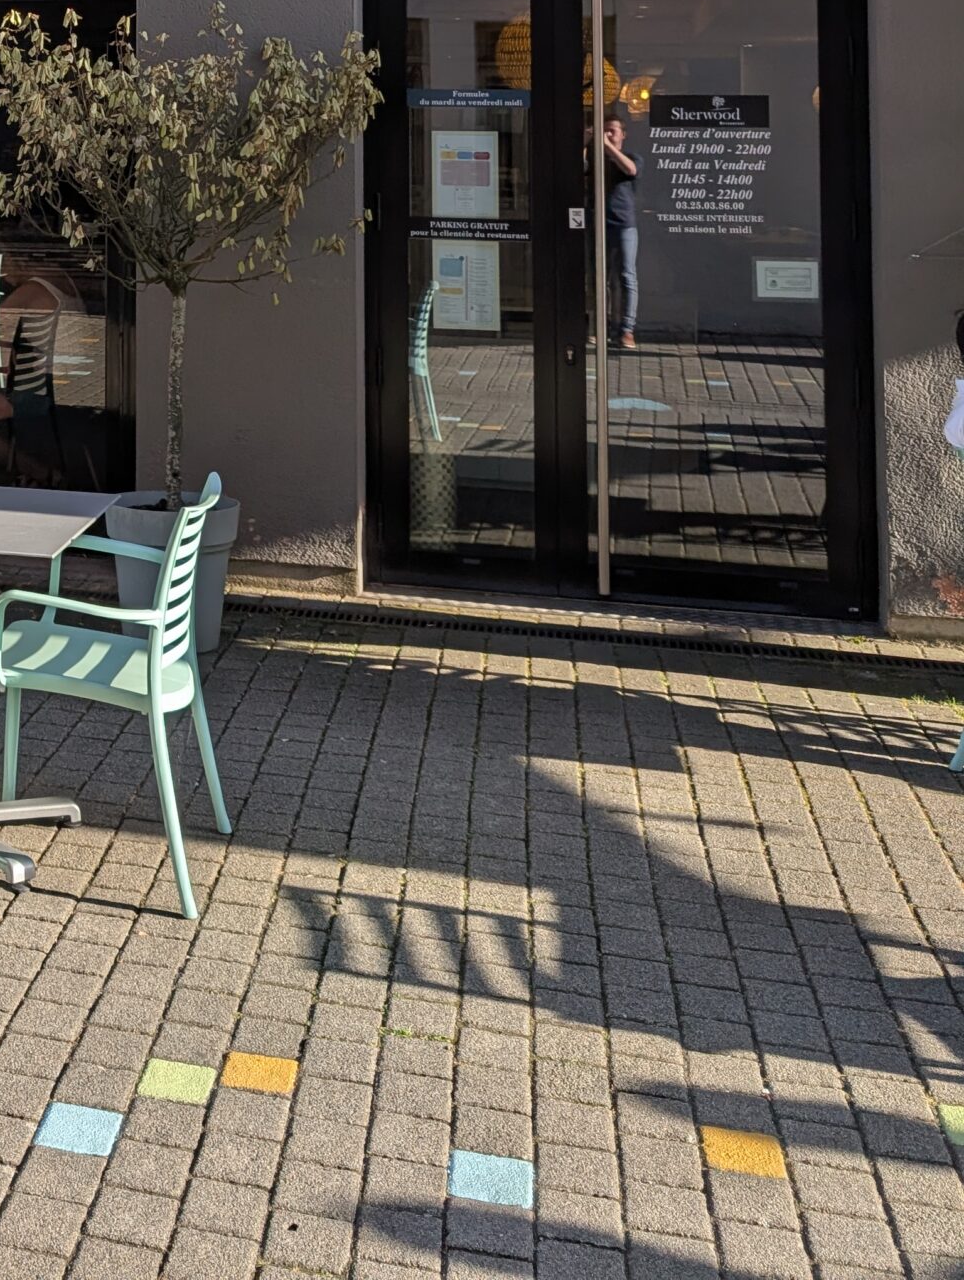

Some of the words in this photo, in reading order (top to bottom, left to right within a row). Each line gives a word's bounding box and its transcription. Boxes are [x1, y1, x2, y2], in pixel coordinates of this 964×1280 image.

[419, 98, 430, 106] du
[431, 98, 455, 106] mardi
[670, 107, 741, 121] Sherwood
[649, 127, 700, 138] Horaires
[702, 128, 772, 139] d’ouverture
[651, 143, 686, 154] Lundi
[689, 143, 724, 154] 19h00
[734, 144, 772, 155] 22h00
[657, 158, 692, 169] Mardi
[694, 161, 710, 170] au
[714, 159, 766, 171] Vendredi
[670, 174, 706, 184] 11h45
[717, 174, 753, 185] 14h00
[670, 188, 706, 199] 19h00
[716, 189, 754, 200] 22h00
[675, 201, 745, 210] 03.25.03.86.00
[656, 213, 704, 222] TERRASSE
[706, 213, 764, 223] INTÉRIEURE
[429, 221, 469, 229] PARKING
[470, 222, 510, 230] GRATUIT
[684, 225, 716, 233] saison
[717, 225, 729, 234] le
[729, 225, 753, 234] midi
[430, 229, 438, 237] la
[474, 230, 485, 238] du
[487, 231, 530, 239] restaurant
